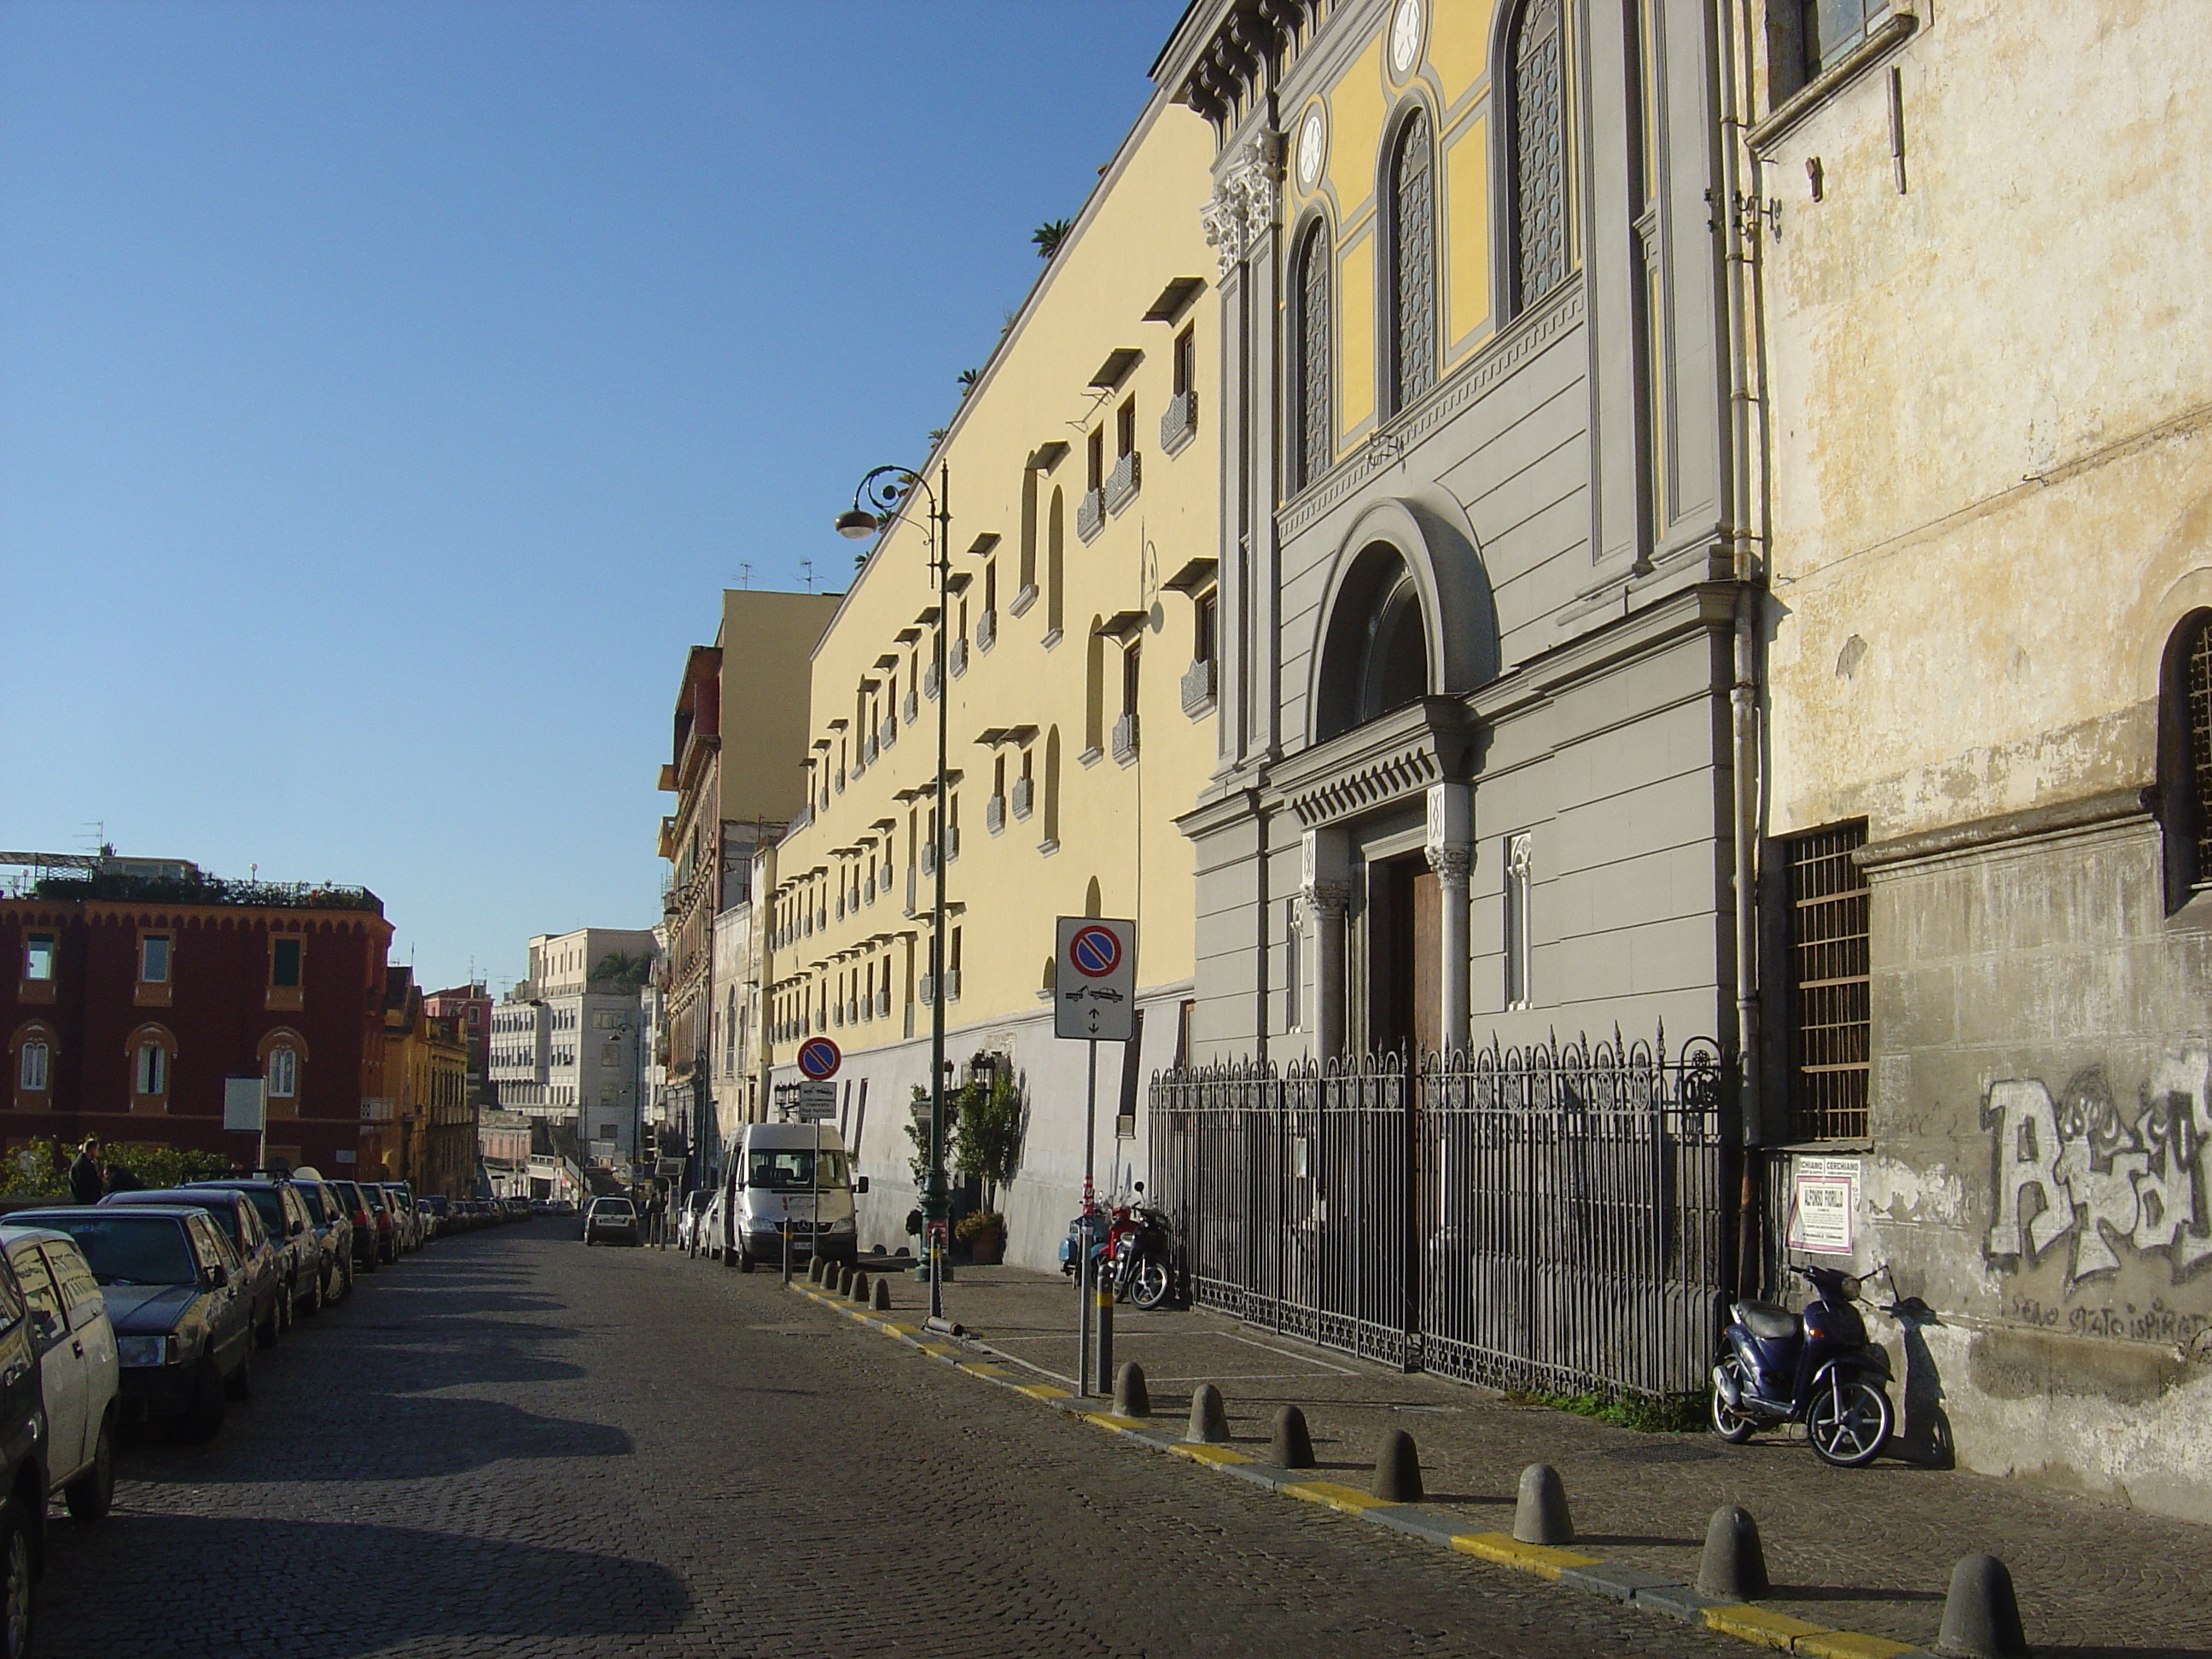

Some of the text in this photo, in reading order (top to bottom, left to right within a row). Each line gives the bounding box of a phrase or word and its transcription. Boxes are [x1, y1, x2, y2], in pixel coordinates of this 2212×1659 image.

[1826, 1161, 1859, 1171] CERCHIAMO
[1804, 1189, 1843, 1208] ALFONSO FIORILLO
